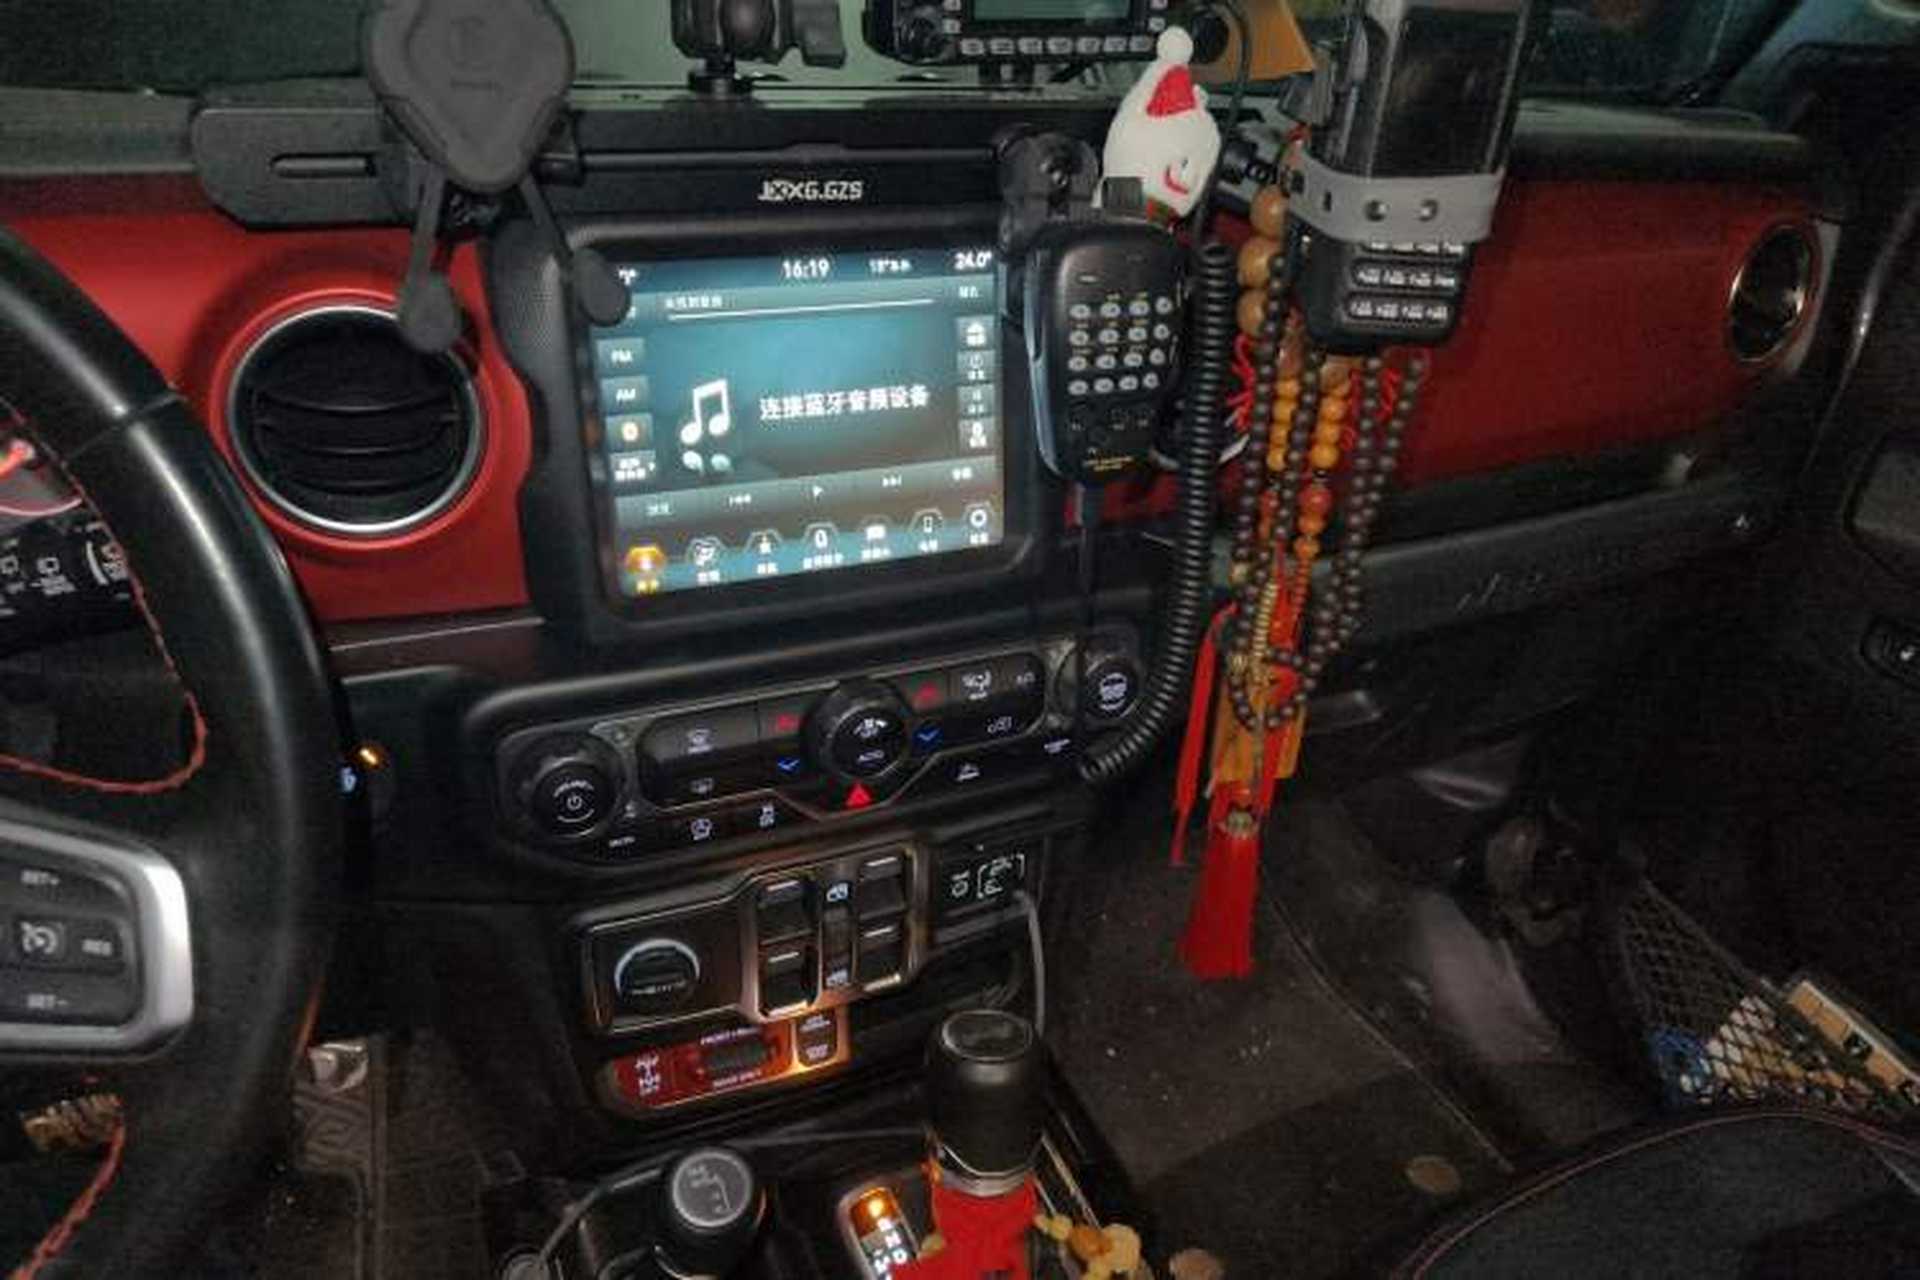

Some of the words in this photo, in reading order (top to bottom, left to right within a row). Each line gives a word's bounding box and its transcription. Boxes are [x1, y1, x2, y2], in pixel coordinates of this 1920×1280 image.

[783, 258, 830, 279] 16:19
[616, 388, 636, 401] AM
[760, 384, 929, 420] 连接蓝牙音频设备
